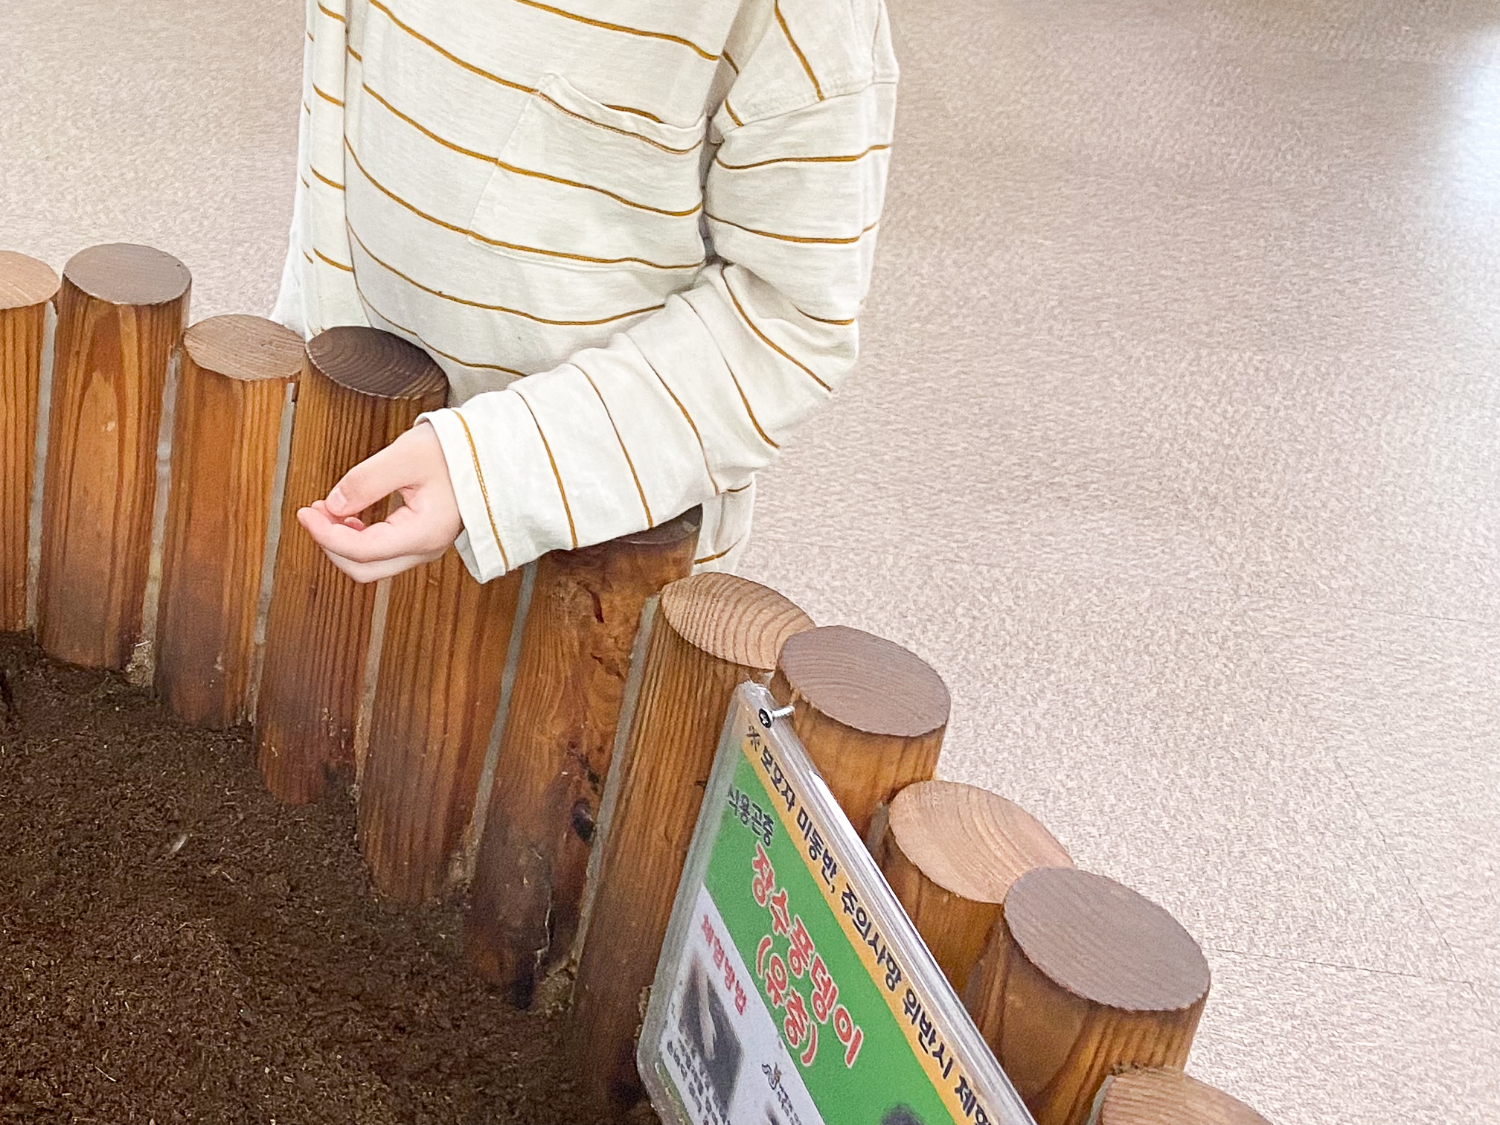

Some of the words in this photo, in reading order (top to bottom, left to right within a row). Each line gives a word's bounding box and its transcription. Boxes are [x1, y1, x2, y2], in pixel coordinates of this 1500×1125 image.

[701, 913, 748, 1016] 체험방법
[751, 841, 864, 1067] 장수풍뎅이
[756, 935, 818, 1067] (유충)
[841, 882, 902, 991] 주의사항
[902, 988, 954, 1080] 위반시
